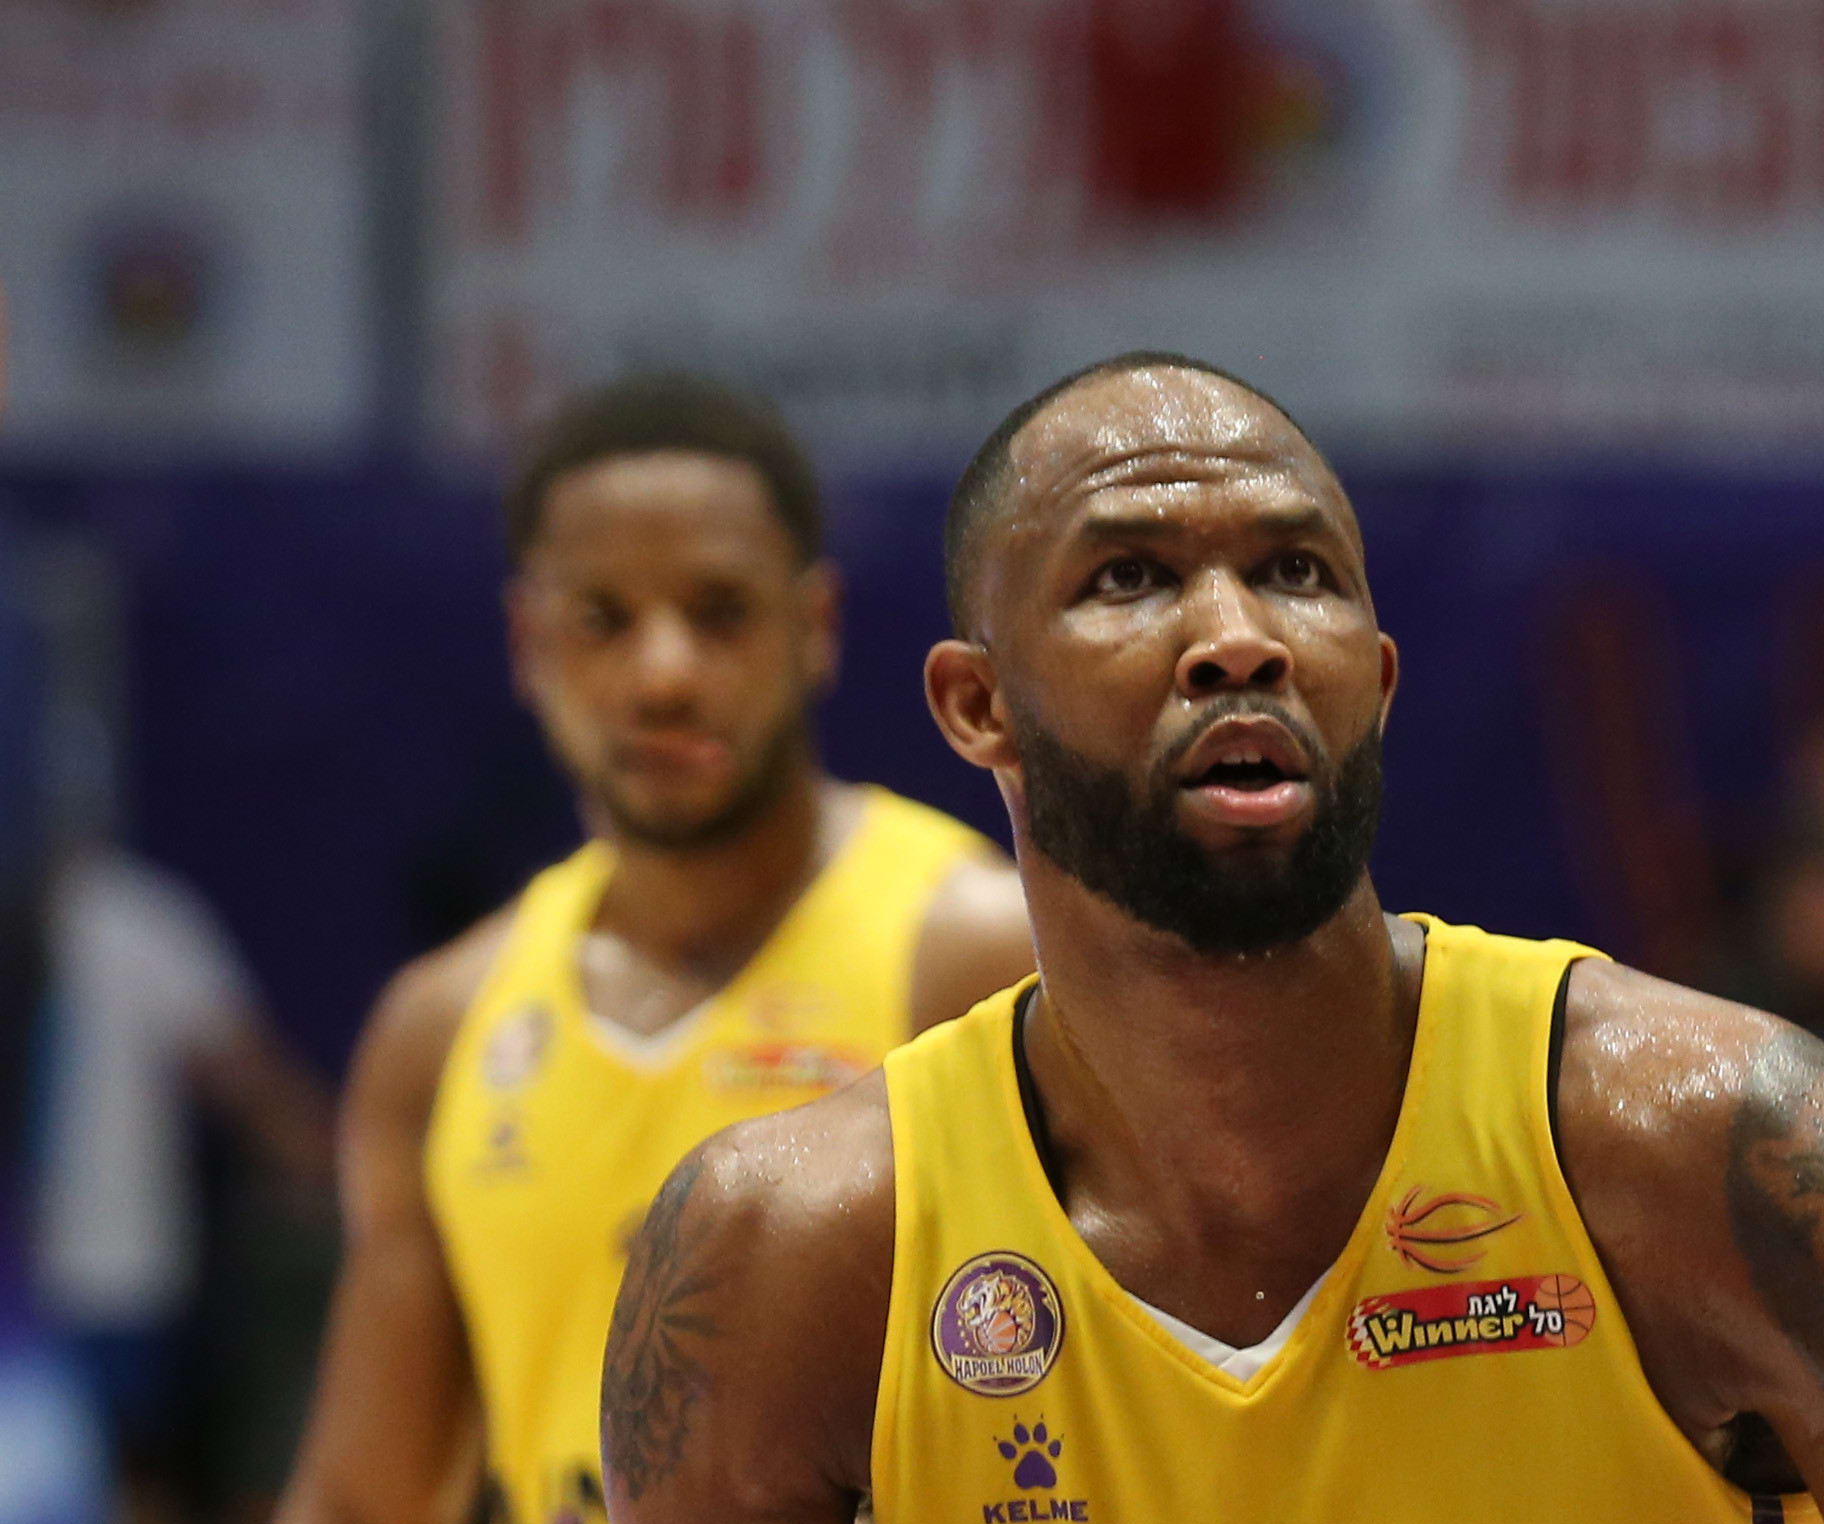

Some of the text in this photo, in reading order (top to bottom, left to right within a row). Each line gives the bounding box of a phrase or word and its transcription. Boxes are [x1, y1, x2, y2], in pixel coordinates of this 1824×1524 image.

[1468, 1285, 1518, 1317] ליגת
[1366, 1303, 1563, 1356] Winner סל
[954, 1355, 1044, 1382] HAPOEL HOLON
